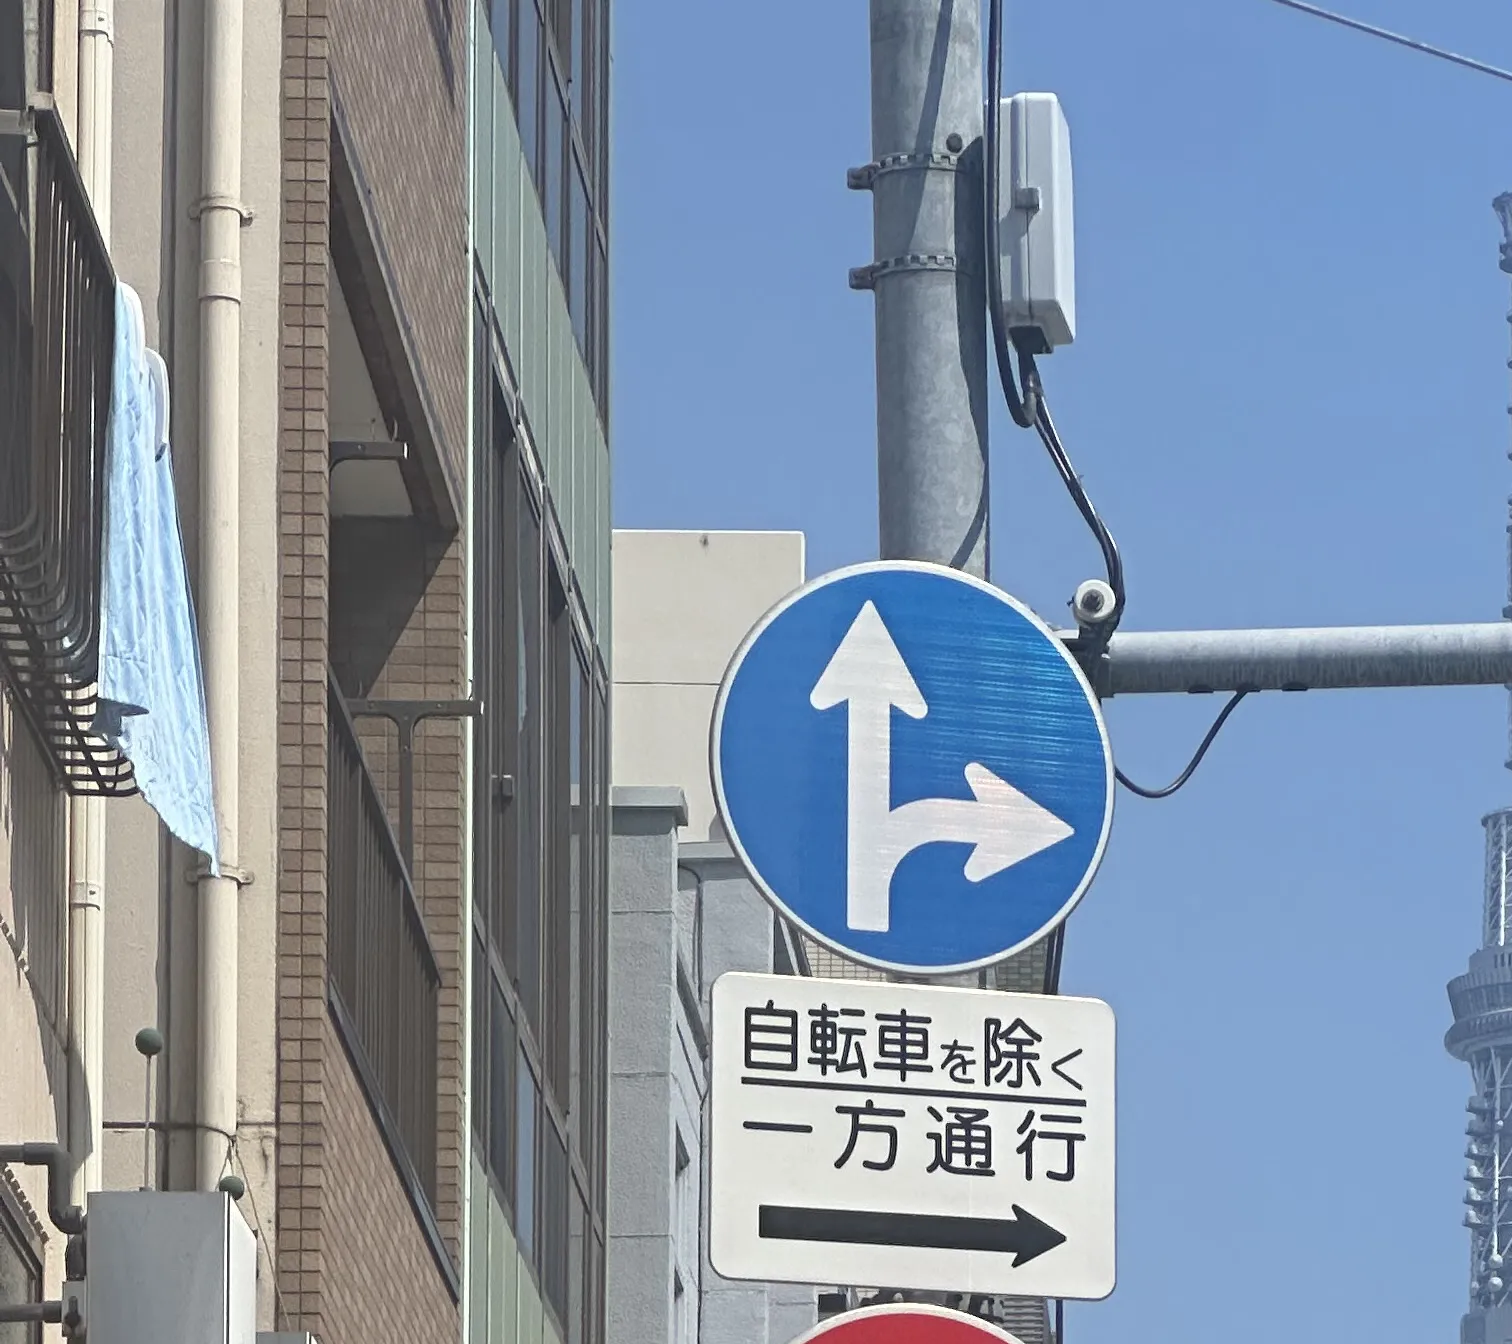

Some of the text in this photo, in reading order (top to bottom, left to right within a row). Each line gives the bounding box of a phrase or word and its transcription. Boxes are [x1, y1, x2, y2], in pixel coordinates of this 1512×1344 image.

[744, 1000, 1083, 1091] 自転車を除く
[743, 1100, 1087, 1182] 一方通行
